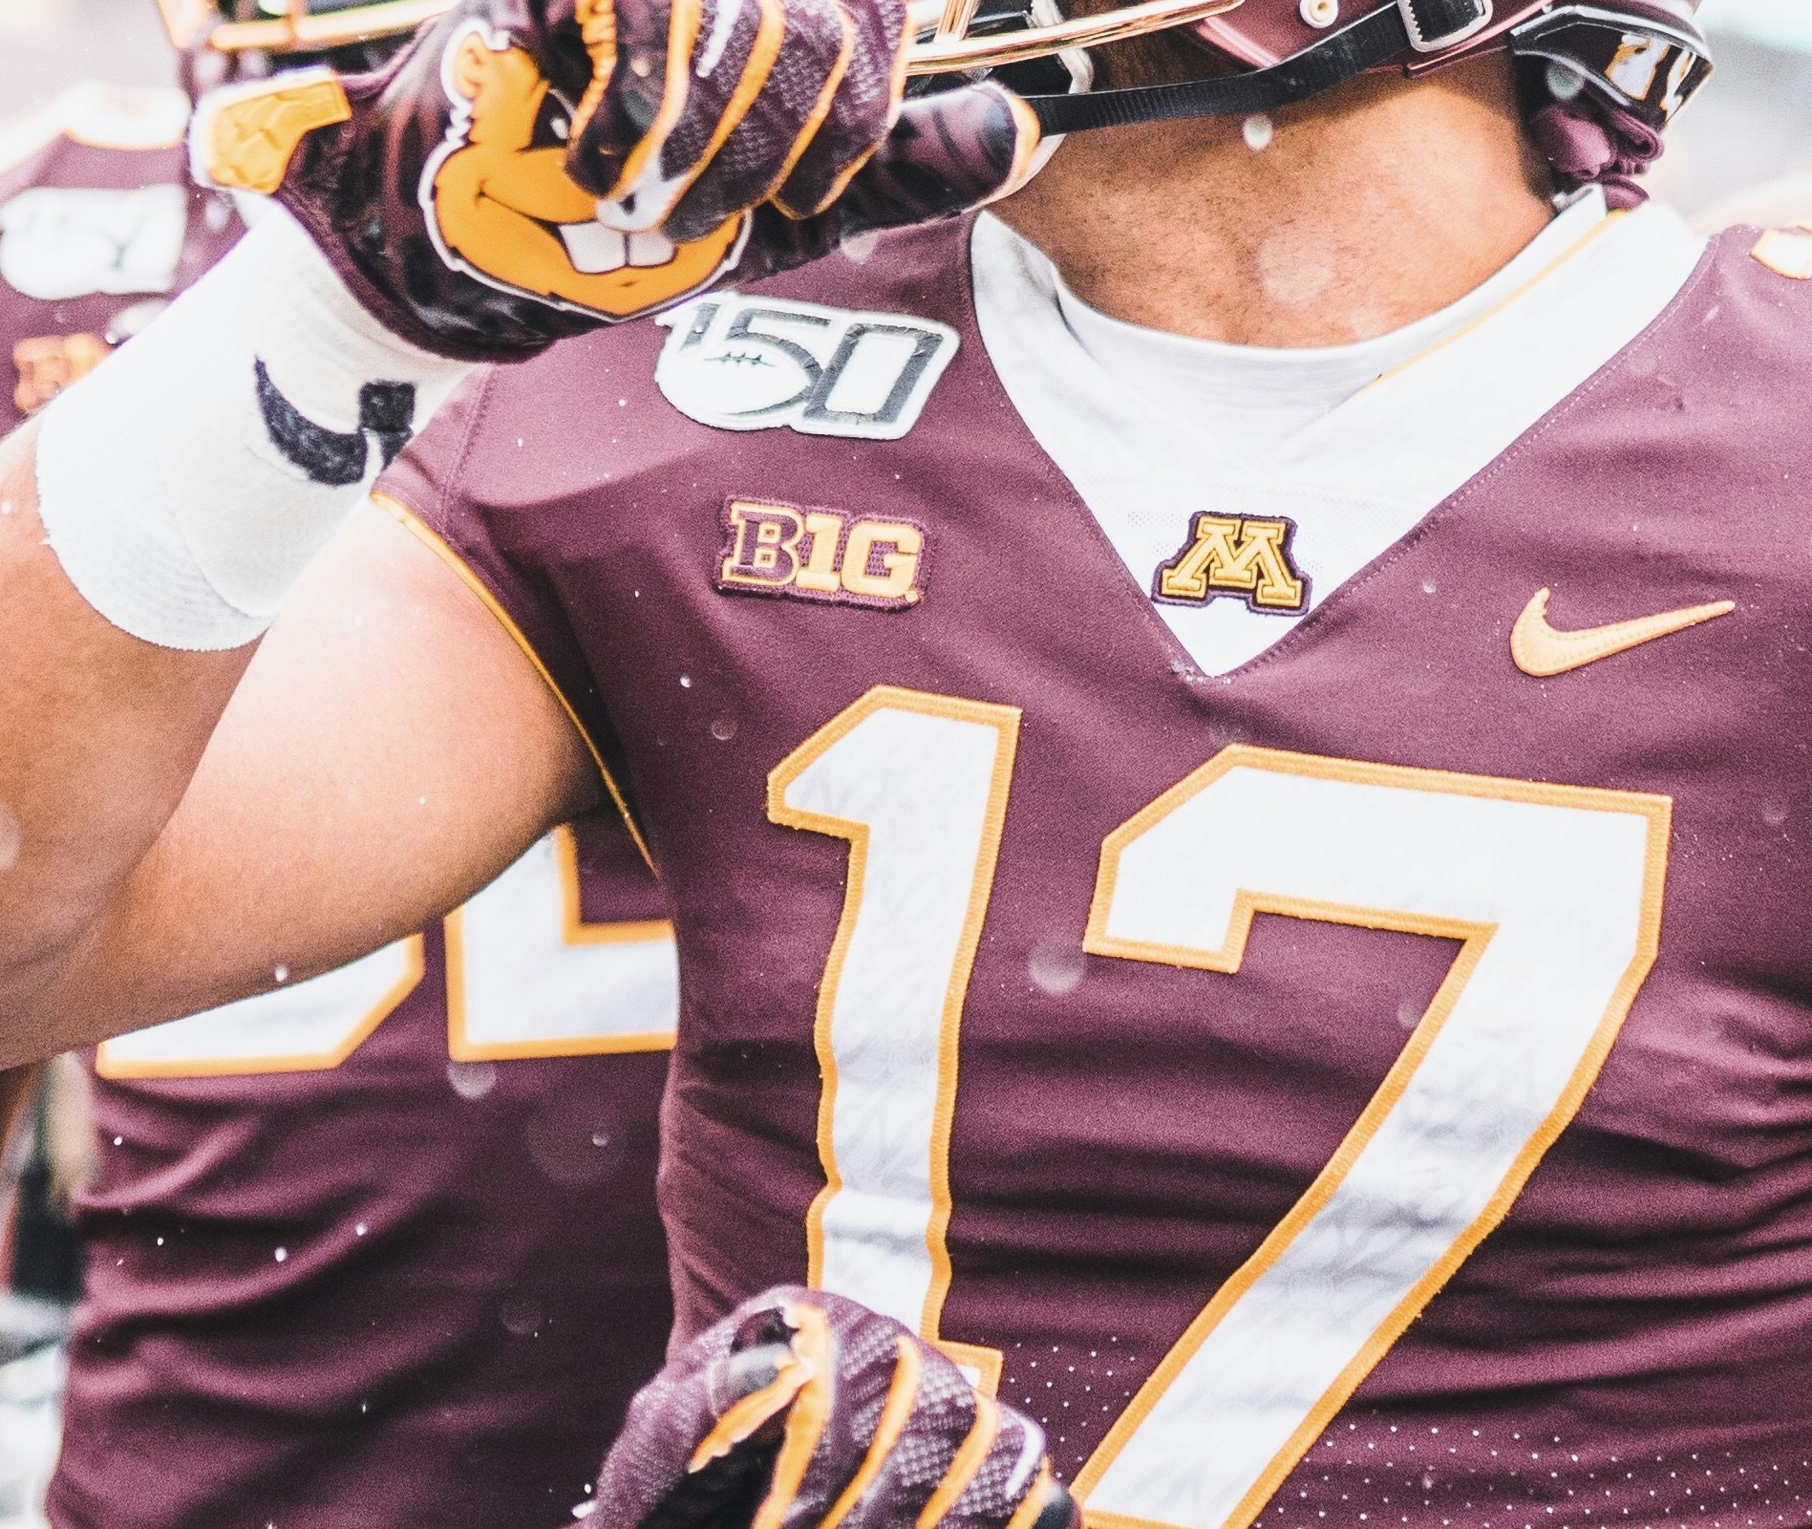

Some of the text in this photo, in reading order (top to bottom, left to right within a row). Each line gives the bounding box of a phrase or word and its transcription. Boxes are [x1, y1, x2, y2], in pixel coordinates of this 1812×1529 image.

[678, 301, 943, 426] 150
[1161, 515, 1303, 608] M
[767, 684, 1672, 1529] 17
